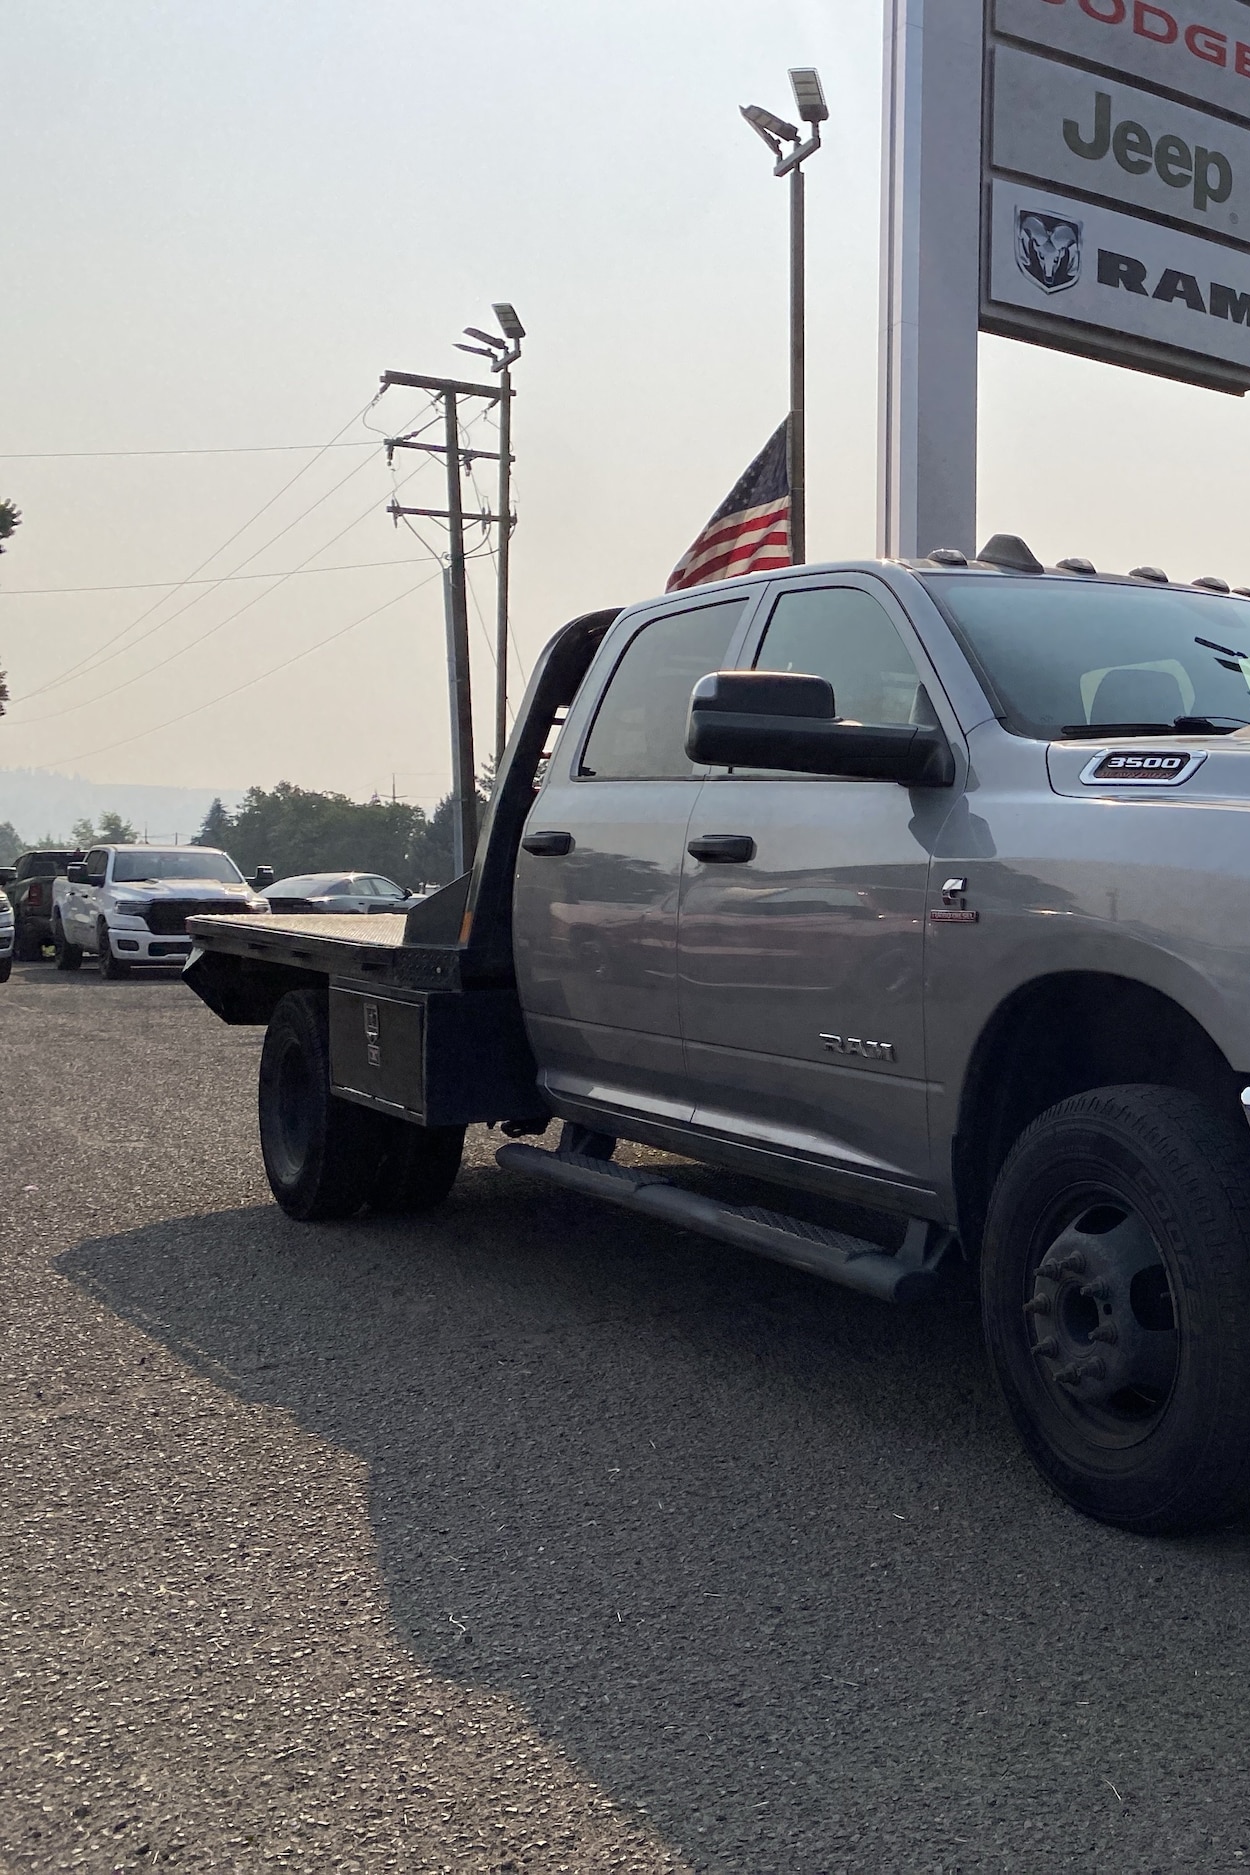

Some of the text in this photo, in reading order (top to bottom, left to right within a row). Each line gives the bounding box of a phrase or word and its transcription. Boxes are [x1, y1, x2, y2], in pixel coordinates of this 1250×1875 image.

[1062, 91, 1233, 211] Jeep
[1107, 757, 1182, 769] 3500
[818, 1033, 896, 1062] RAM
